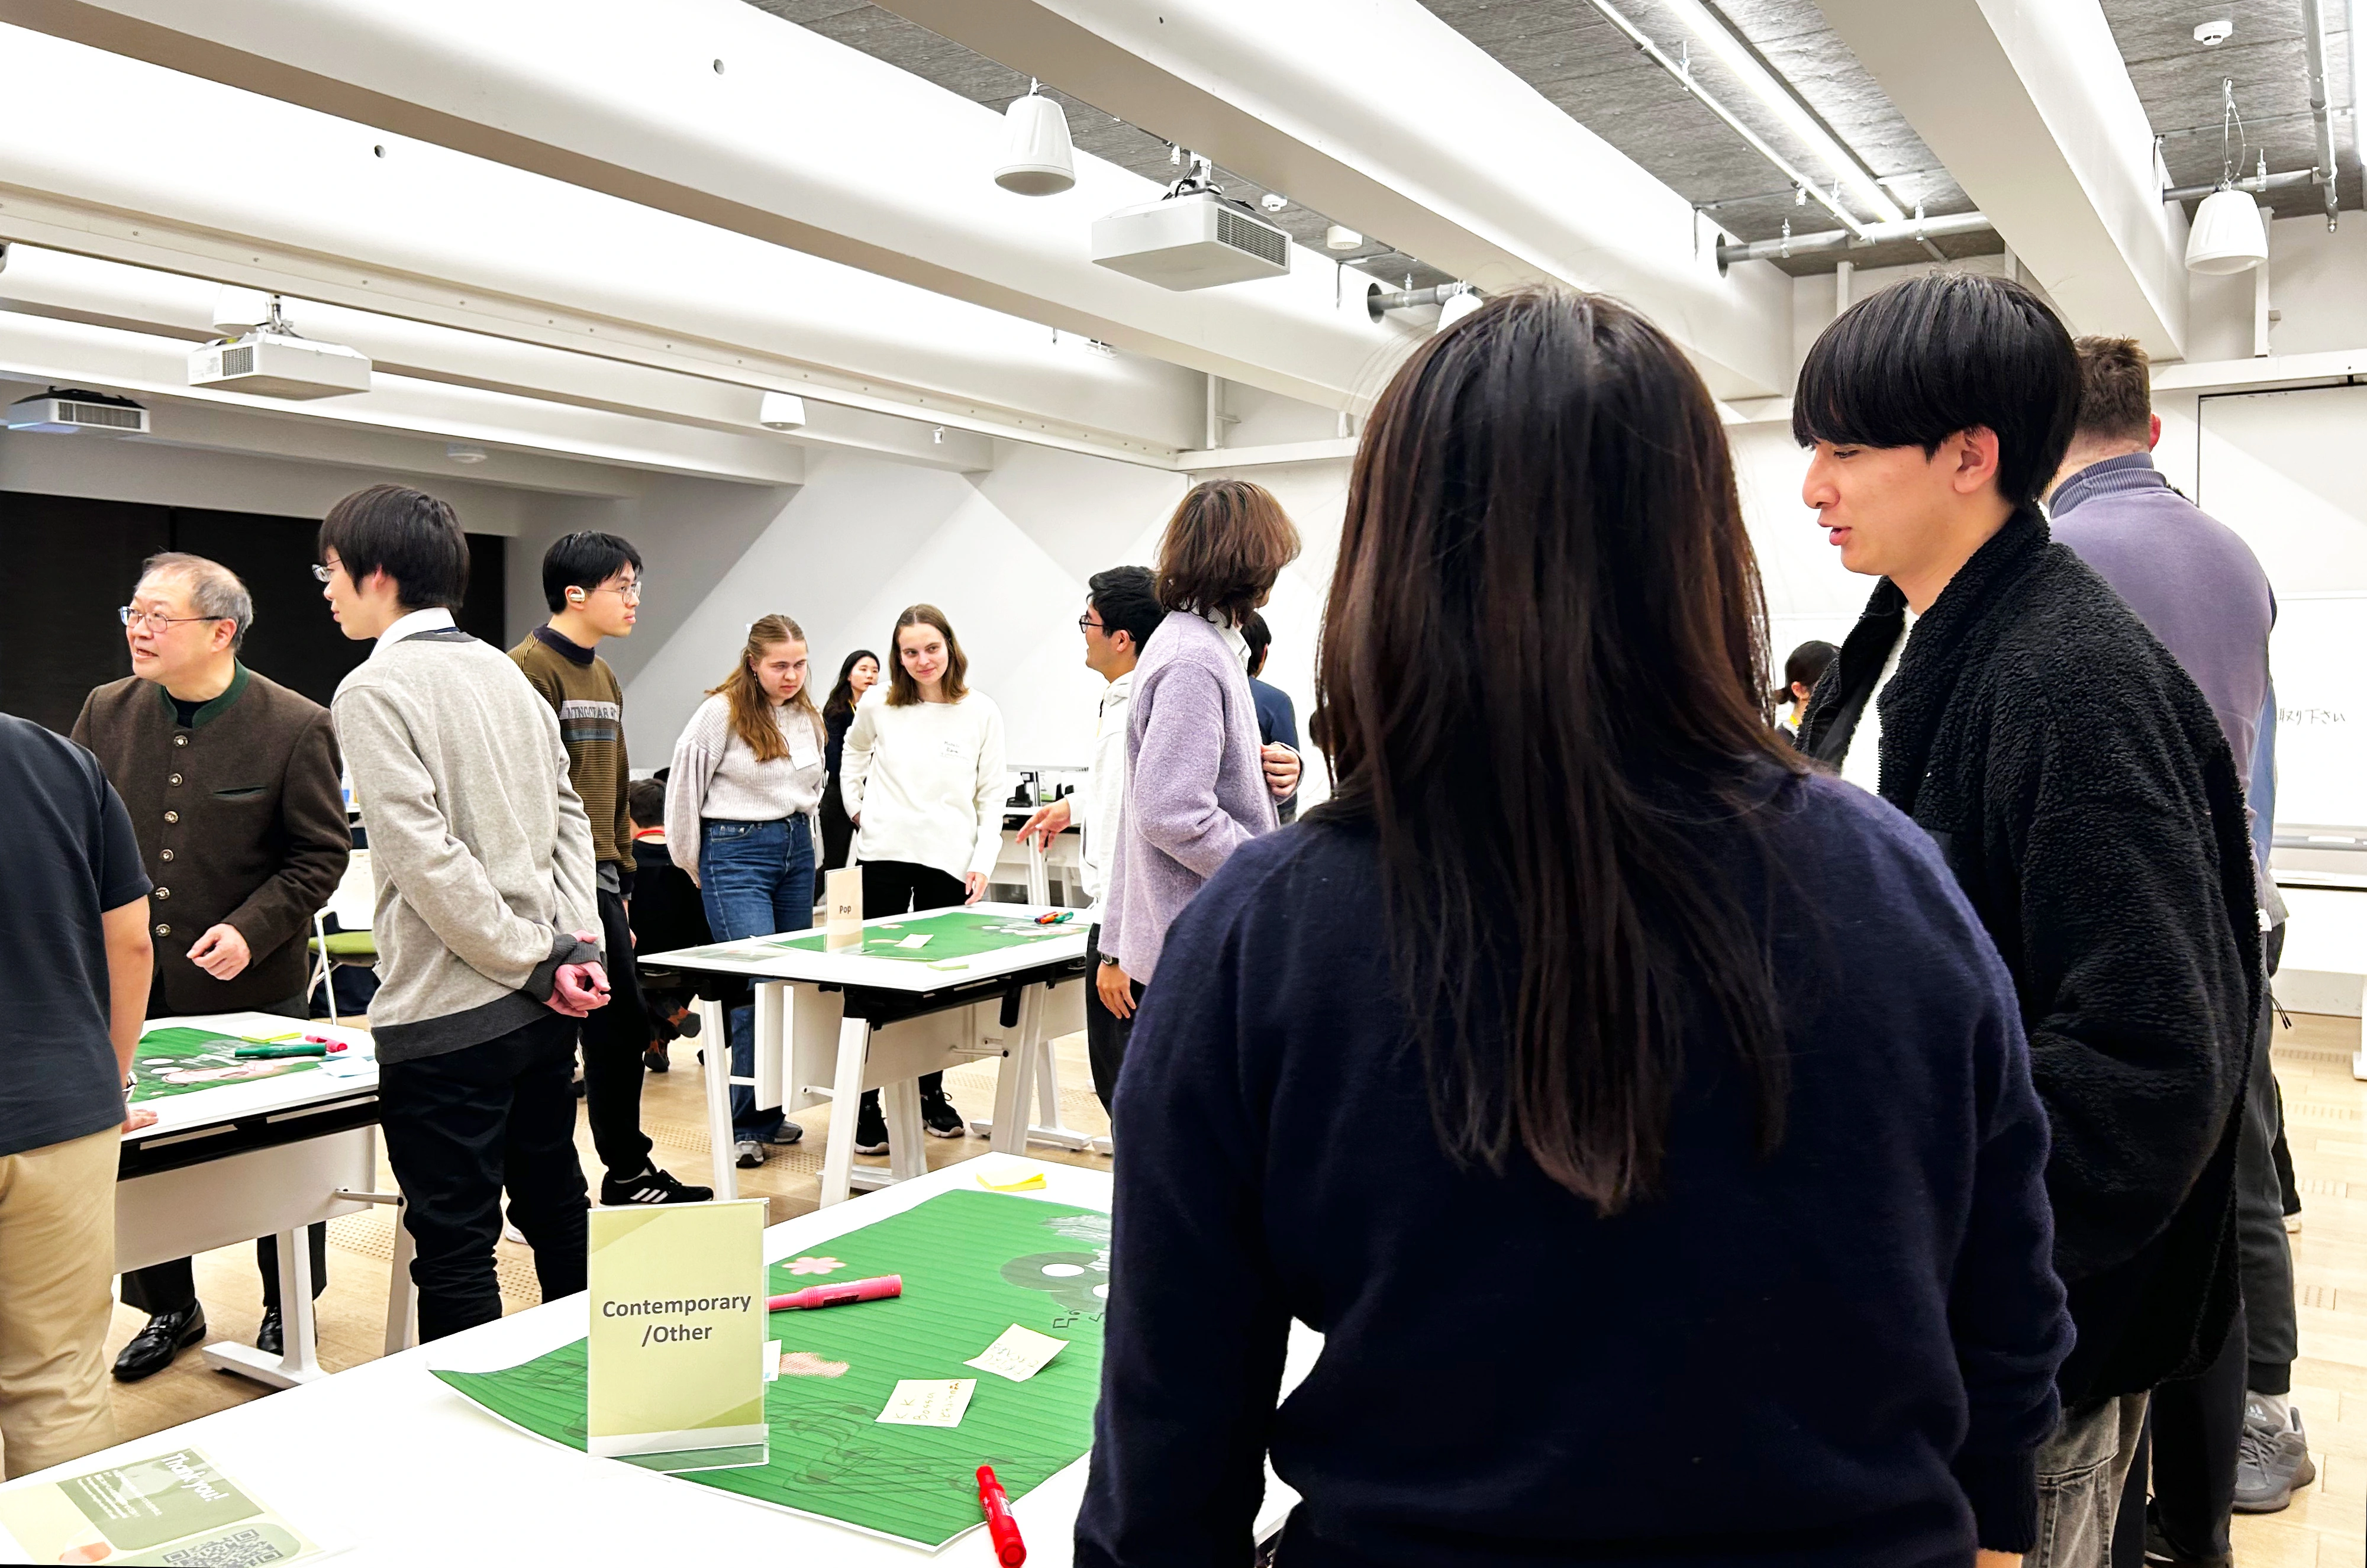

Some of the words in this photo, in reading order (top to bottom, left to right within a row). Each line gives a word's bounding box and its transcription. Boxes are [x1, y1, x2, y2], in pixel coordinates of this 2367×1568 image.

[839, 905, 852, 914] Pop
[602, 1296, 752, 1317] Contemporary
[641, 1324, 712, 1347] /Other
[161, 1453, 206, 1483] Thank
[180, 1480, 230, 1502] you!
